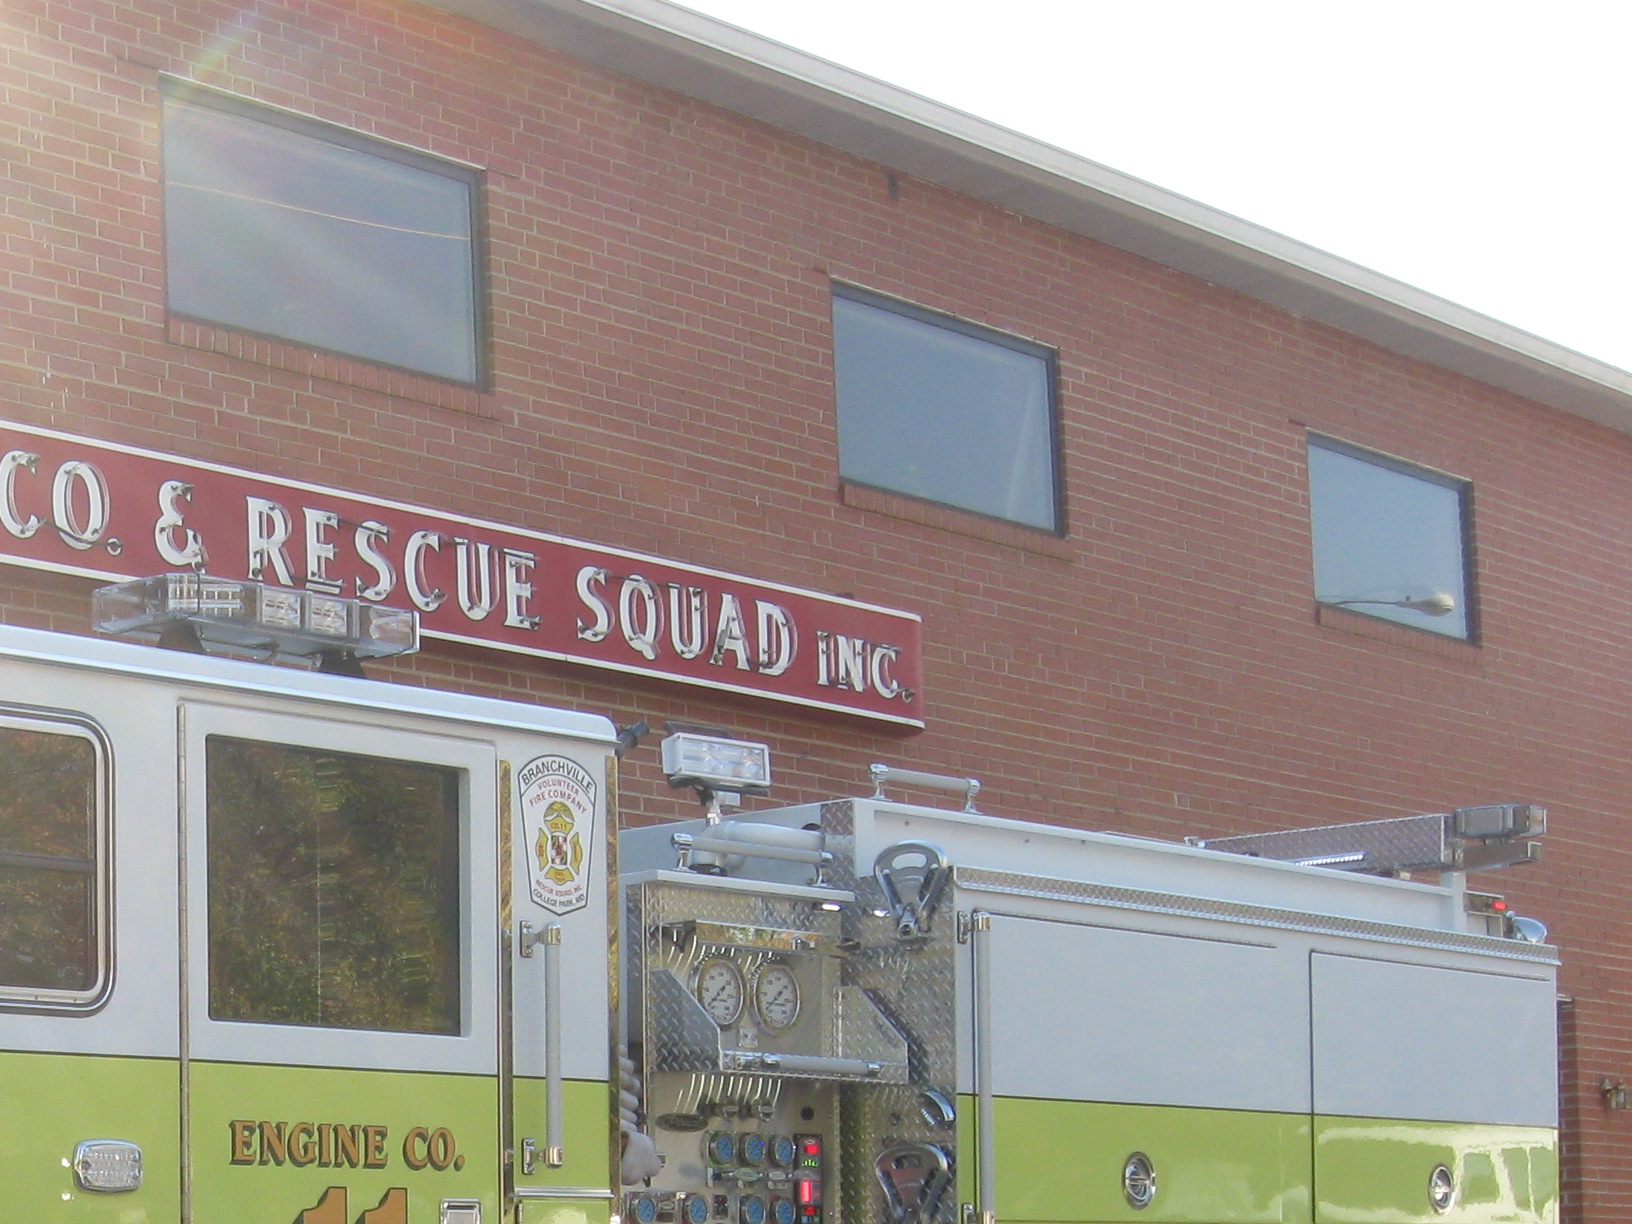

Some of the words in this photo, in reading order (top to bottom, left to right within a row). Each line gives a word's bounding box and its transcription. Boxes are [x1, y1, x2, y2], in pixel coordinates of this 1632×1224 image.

[154, 480, 209, 573] &
[245, 496, 541, 630] RESCUE
[575, 565, 796, 676] SQUAD
[816, 630, 913, 704] INC.
[521, 760, 593, 794] BRANCHVILLE
[537, 779, 580, 796] VOLUNTEER
[529, 792, 547, 807] FIRE
[548, 789, 588, 814] COMPANY
[229, 1119, 388, 1169] ENGINE
[403, 1126, 466, 1170] CO.
